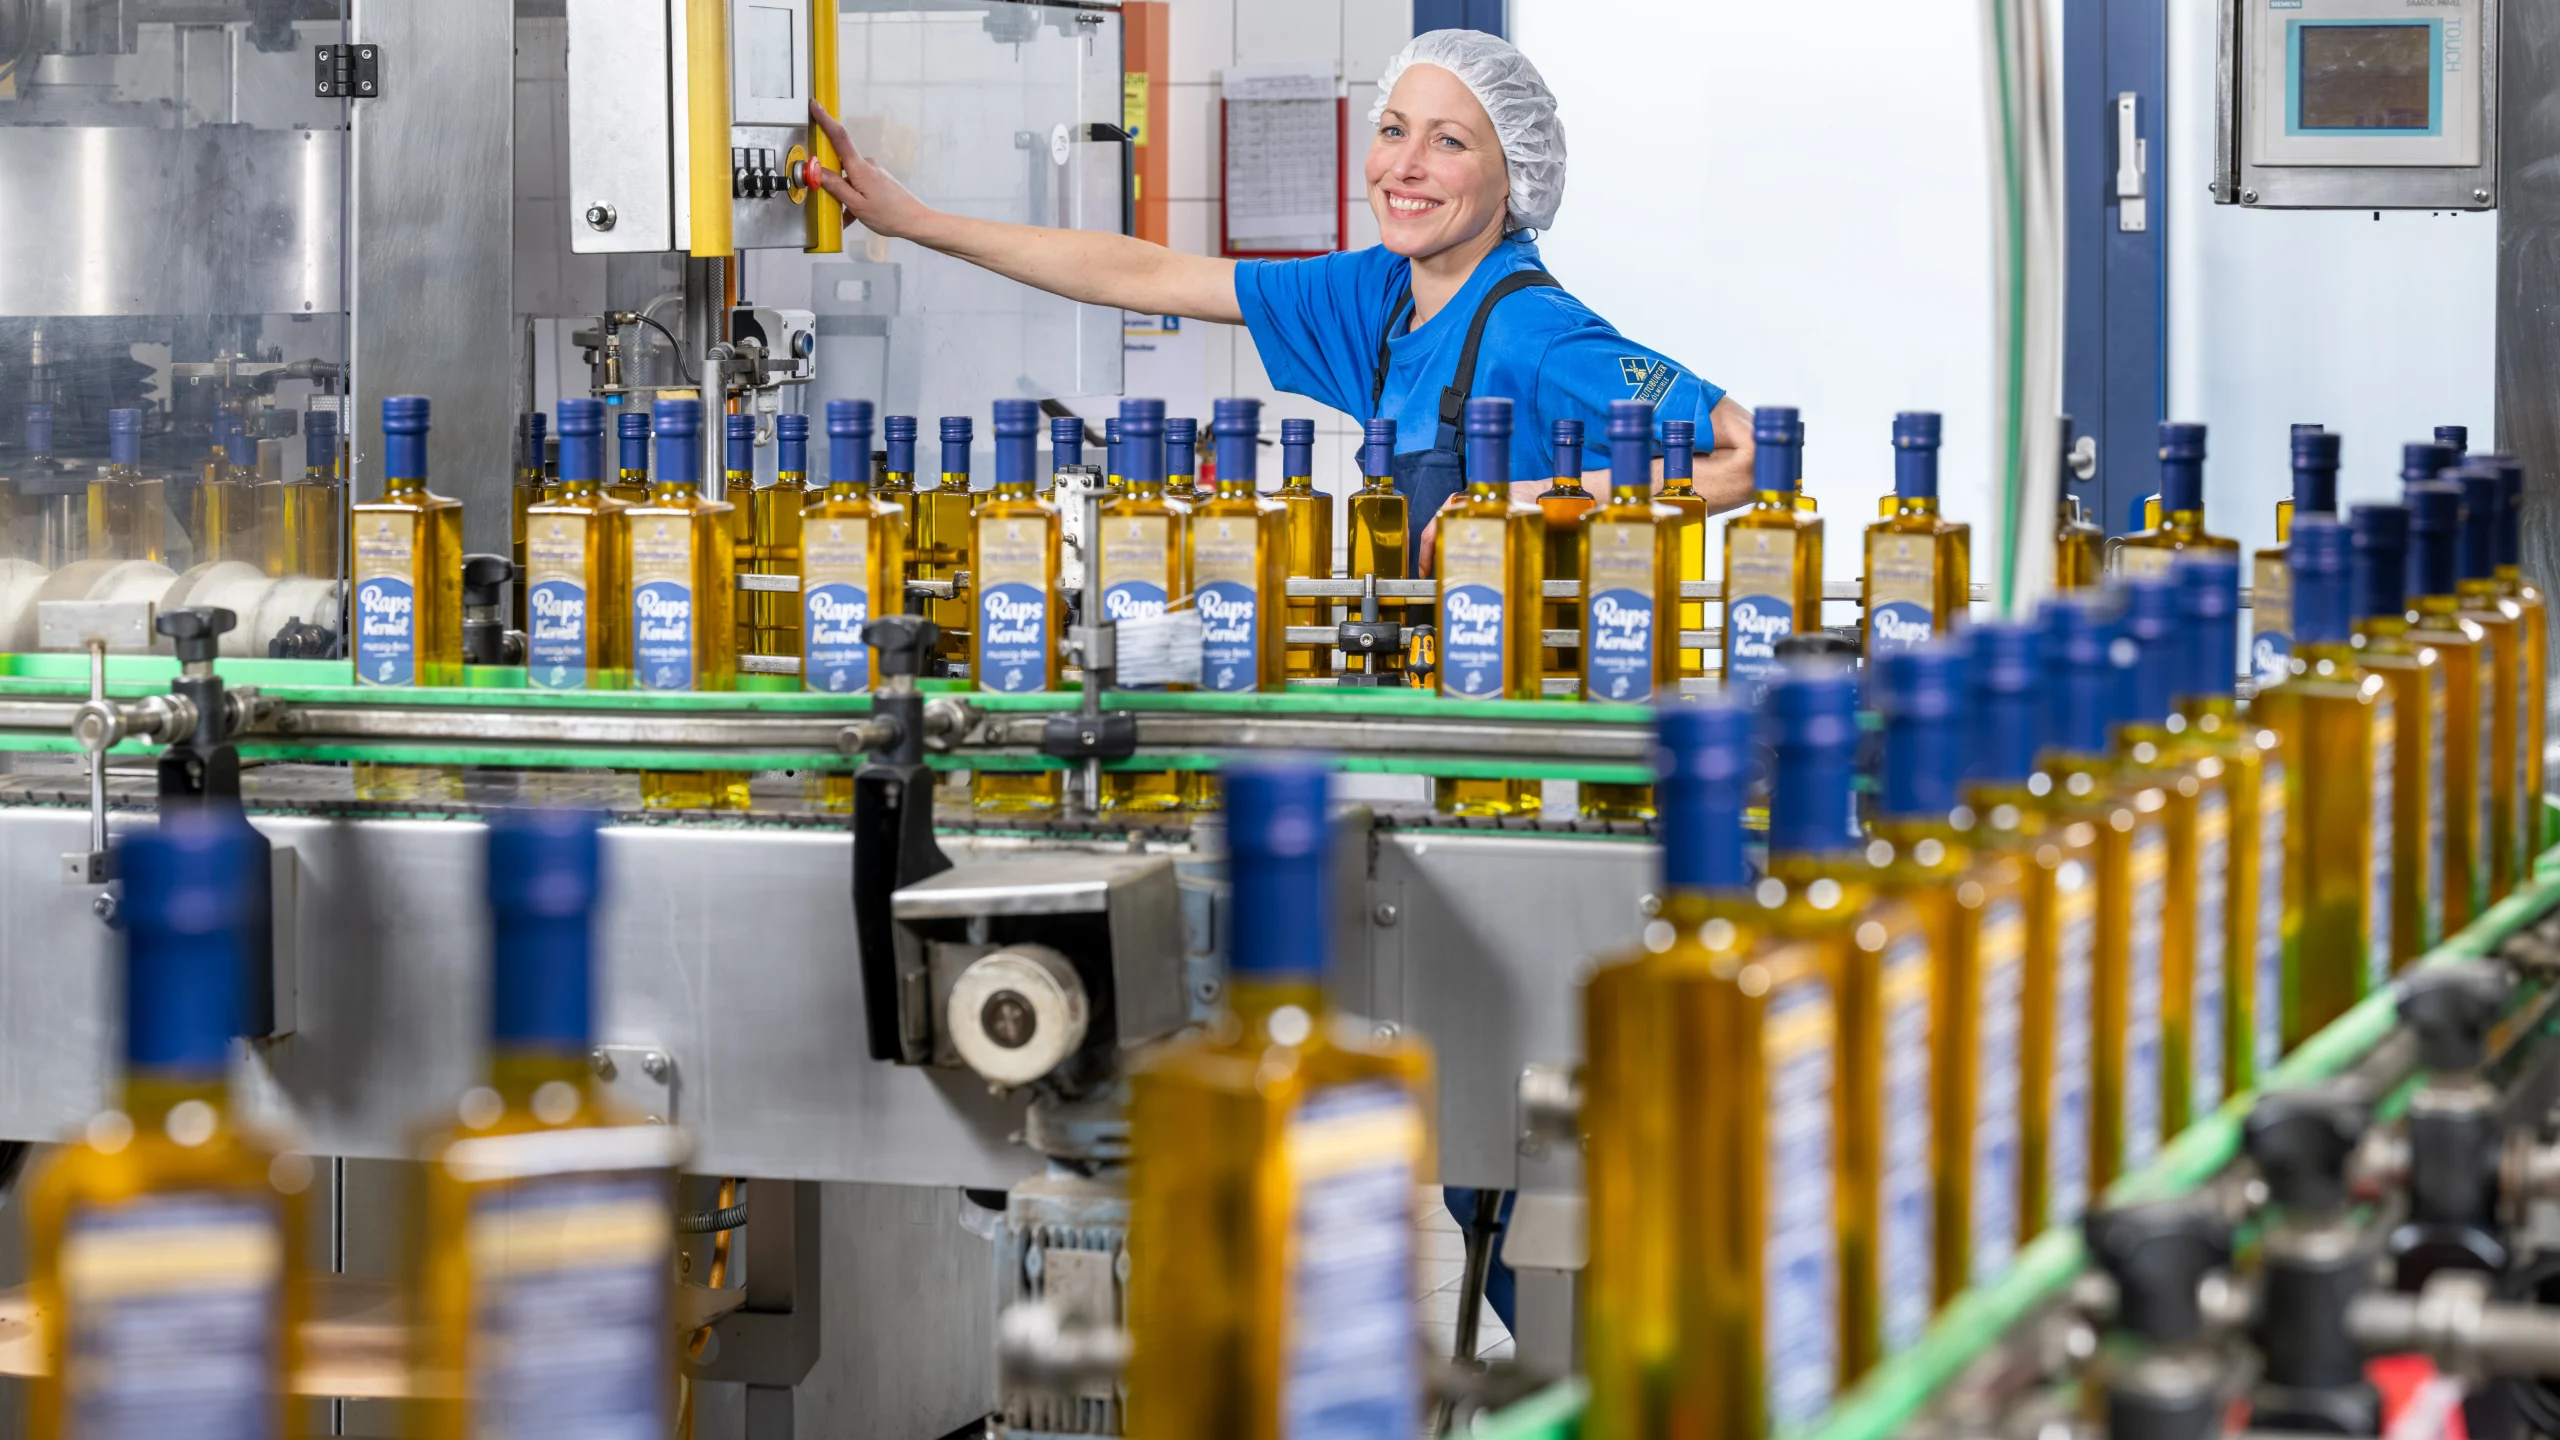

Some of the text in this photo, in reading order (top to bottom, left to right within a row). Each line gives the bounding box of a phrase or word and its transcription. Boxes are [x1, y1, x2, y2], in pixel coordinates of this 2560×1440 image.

[2445, 18, 2461, 73] TOUCH
[360, 585, 412, 622] Raps
[532, 588, 584, 626] Raps
[637, 589, 690, 627] Raps
[809, 592, 866, 630] Raps
[984, 591, 1044, 629] Raps
[1198, 590, 1254, 628] Raps
[1447, 592, 1502, 631] Raps
[1593, 596, 1652, 636] Raps
[363, 615, 410, 636] Kernöl
[987, 622, 1040, 644] Kernöl
[1449, 624, 1498, 646] Kernöl
[1595, 628, 1648, 652] Kernöl
[1732, 603, 1791, 643] Raps
